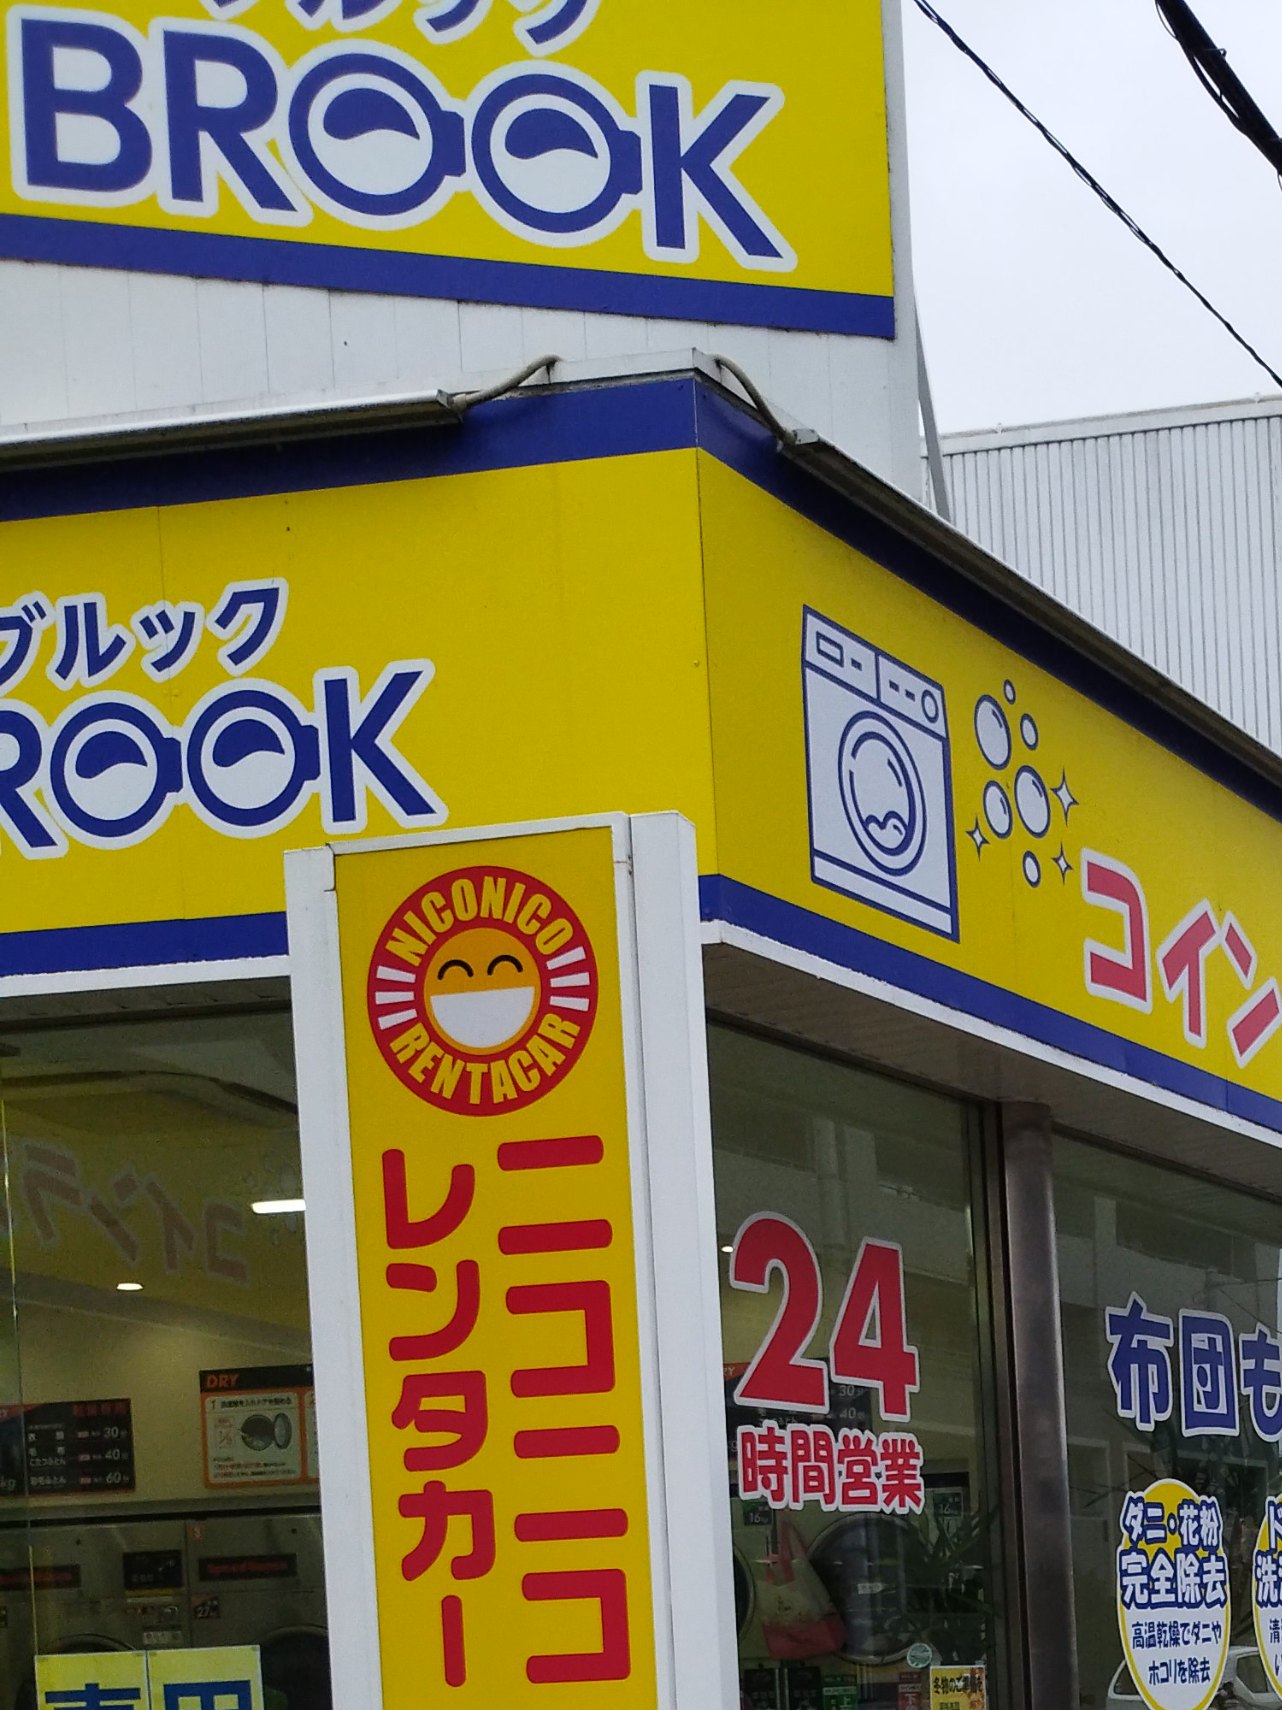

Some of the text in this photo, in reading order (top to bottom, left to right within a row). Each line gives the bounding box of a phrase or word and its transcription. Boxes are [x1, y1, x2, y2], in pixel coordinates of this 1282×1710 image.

[20, 17, 786, 260] BROOK
[384, 875, 576, 967] NICONICO
[390, 1011, 582, 1105] RENTACAR
[732, 1216, 920, 1418] 24
[206, 1374, 240, 1389] DRY
[382, 1148, 497, 1688] レンタカー
[497, 1134, 632, 1685] ニコニコ
[740, 1427, 924, 1509] 時間営業
[1124, 1500, 1219, 1547] ダニ・花粉
[1120, 1550, 1228, 1604] 完全除去
[1131, 1620, 1223, 1650] 高温乾燥でダニや
[1148, 1656, 1212, 1687] ホコリを除去
